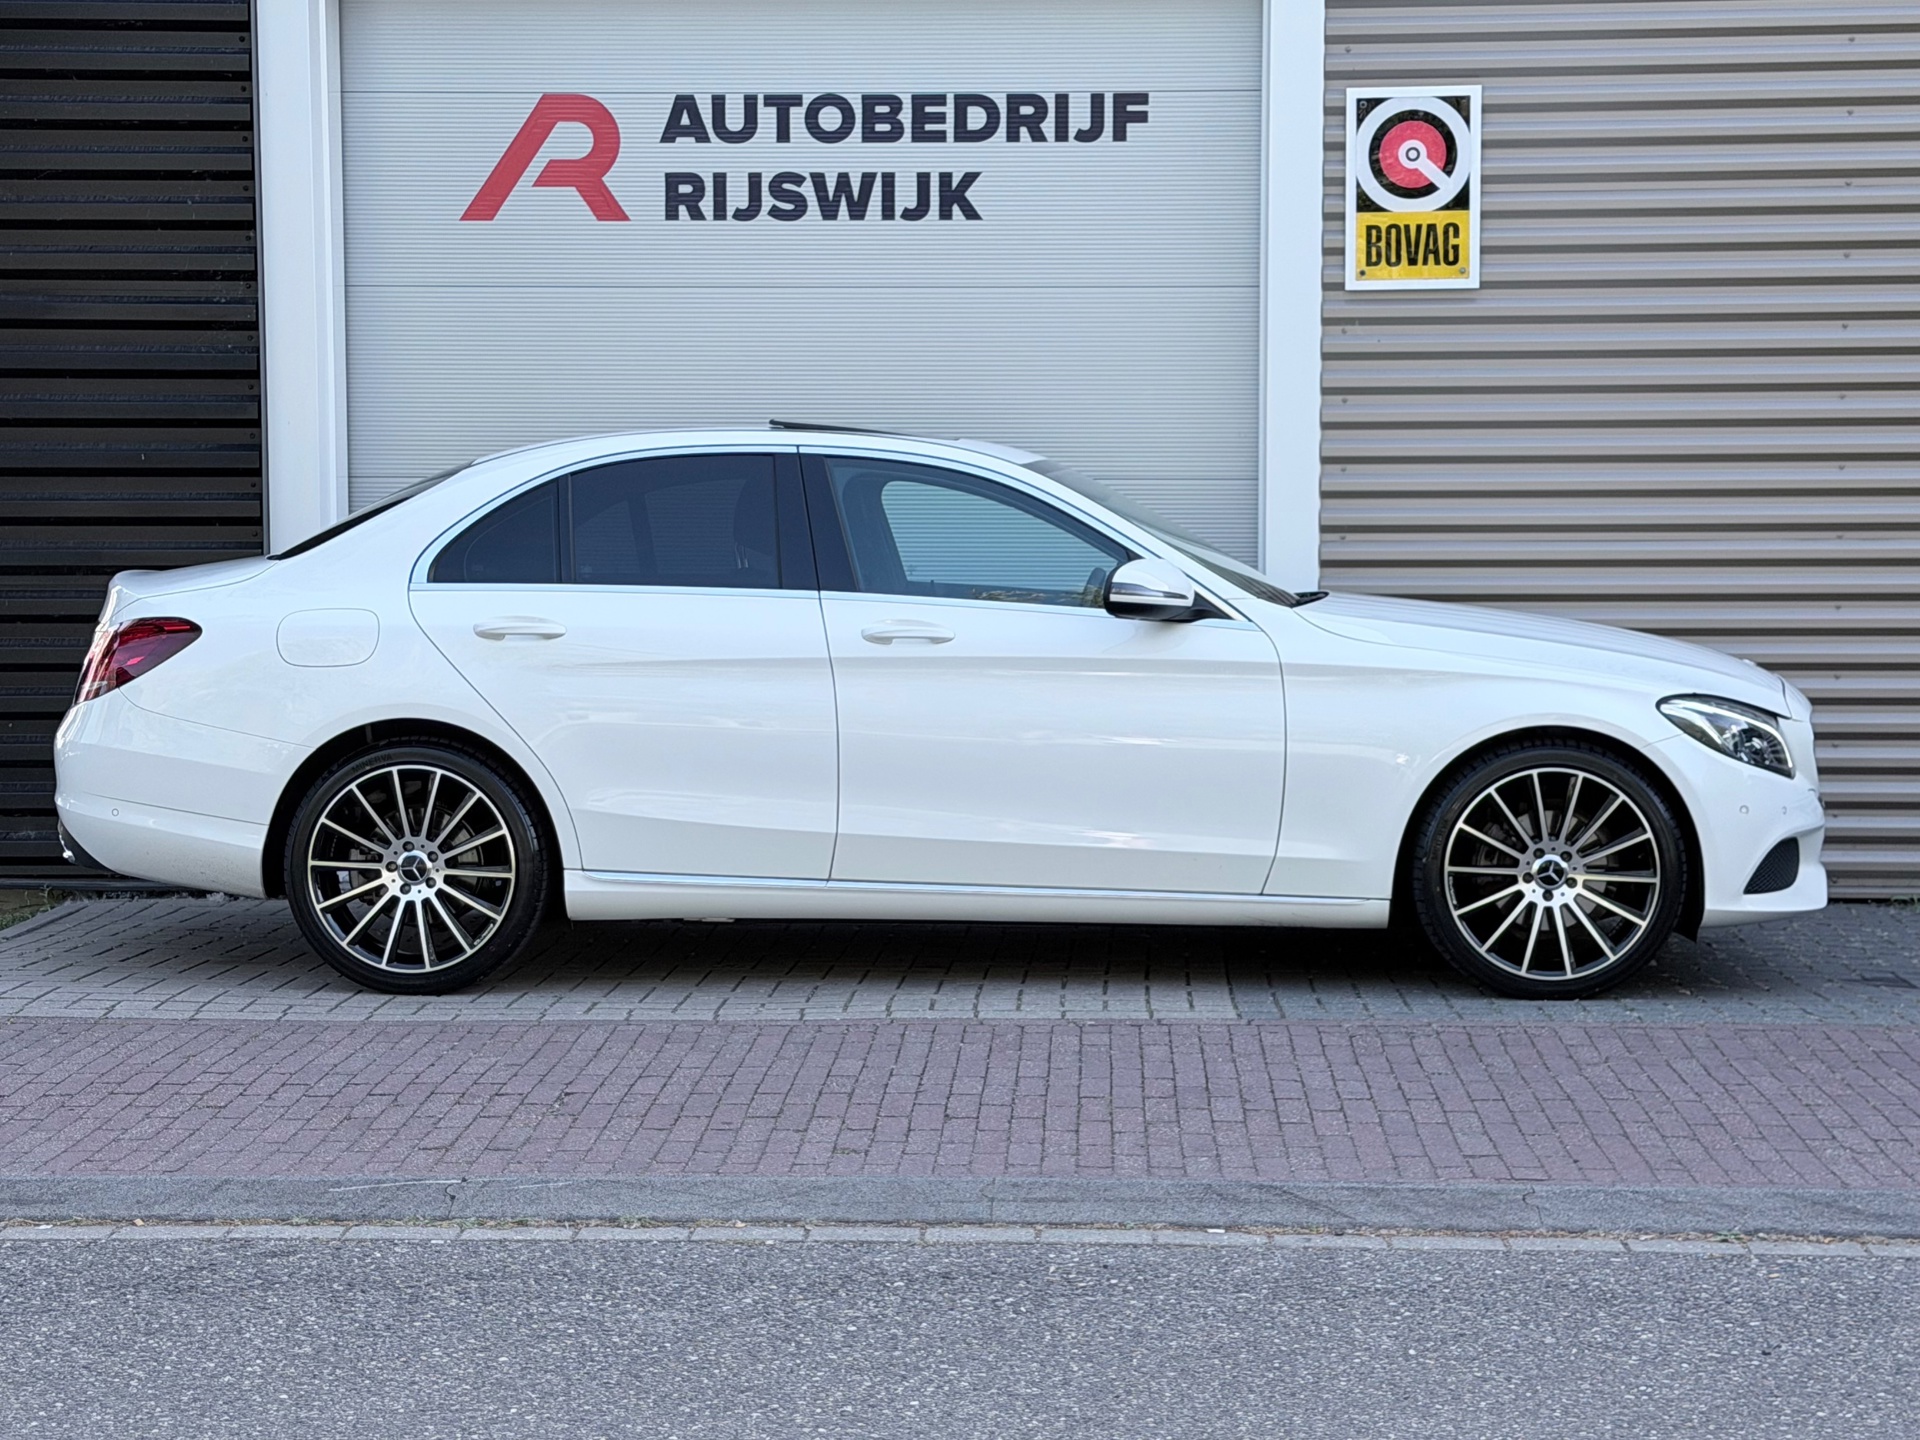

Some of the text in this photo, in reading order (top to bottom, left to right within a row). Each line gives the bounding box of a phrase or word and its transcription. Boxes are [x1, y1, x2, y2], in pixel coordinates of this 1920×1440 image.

[660, 93, 1149, 143] AUTOBEDRIJF
[665, 171, 983, 221] RIJSWIJK
[1365, 222, 1460, 267] BOVAG
[352, 753, 393, 772] MINERVA
